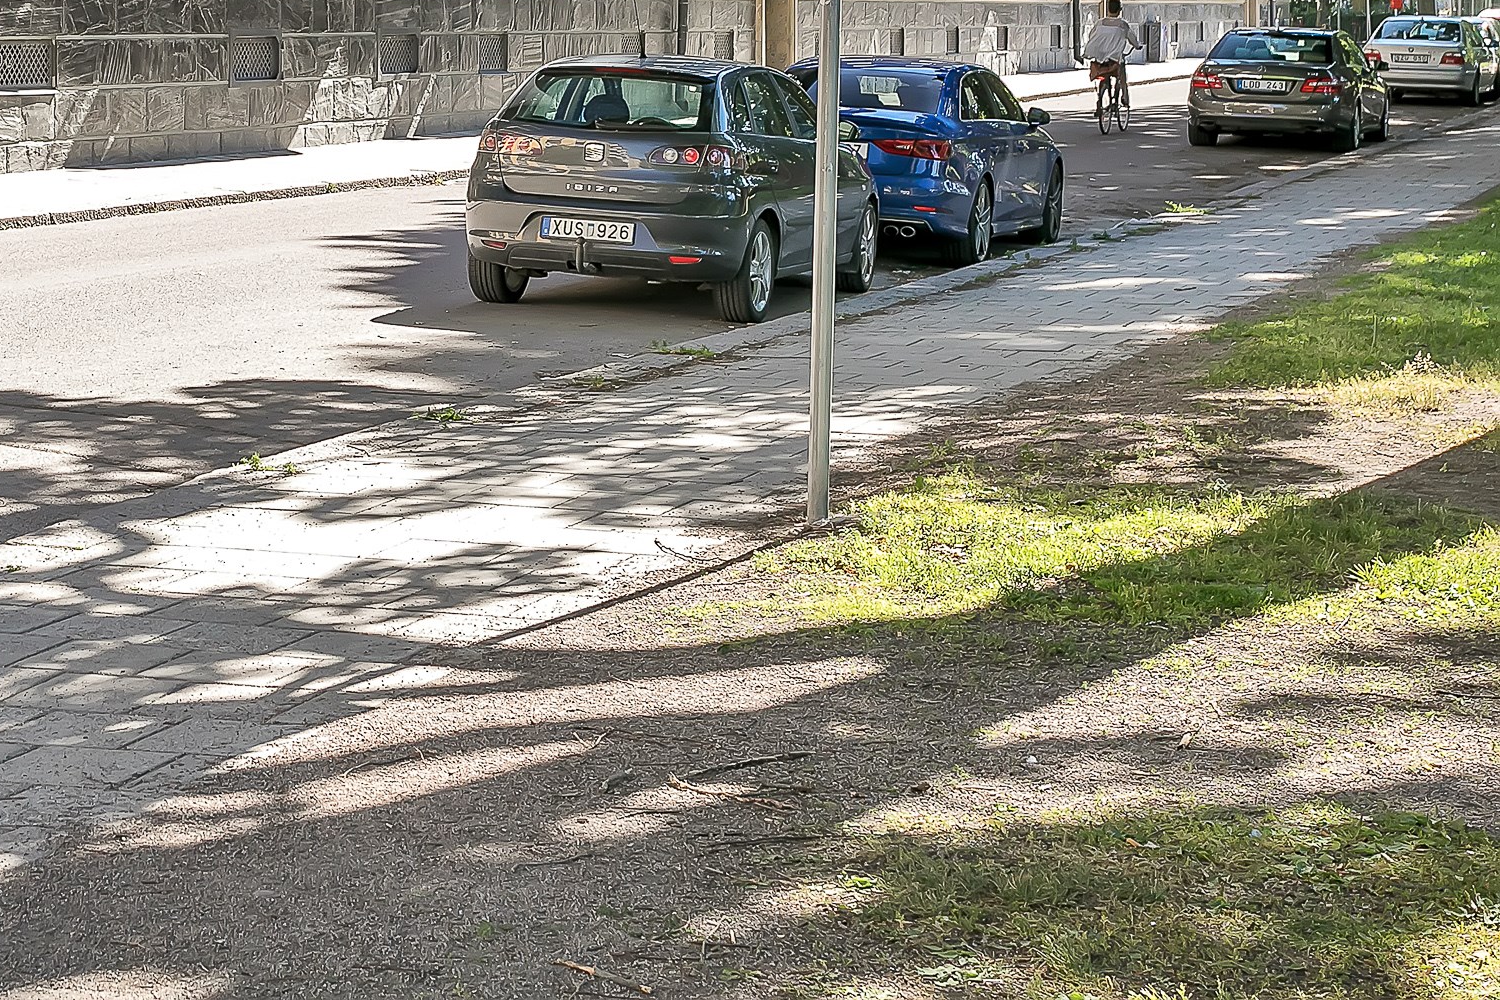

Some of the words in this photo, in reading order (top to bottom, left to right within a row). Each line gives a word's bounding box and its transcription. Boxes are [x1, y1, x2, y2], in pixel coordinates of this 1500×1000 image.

[566, 183, 619, 193] IBIZA
[552, 220, 584, 236] XUS
[597, 223, 630, 240] 926
